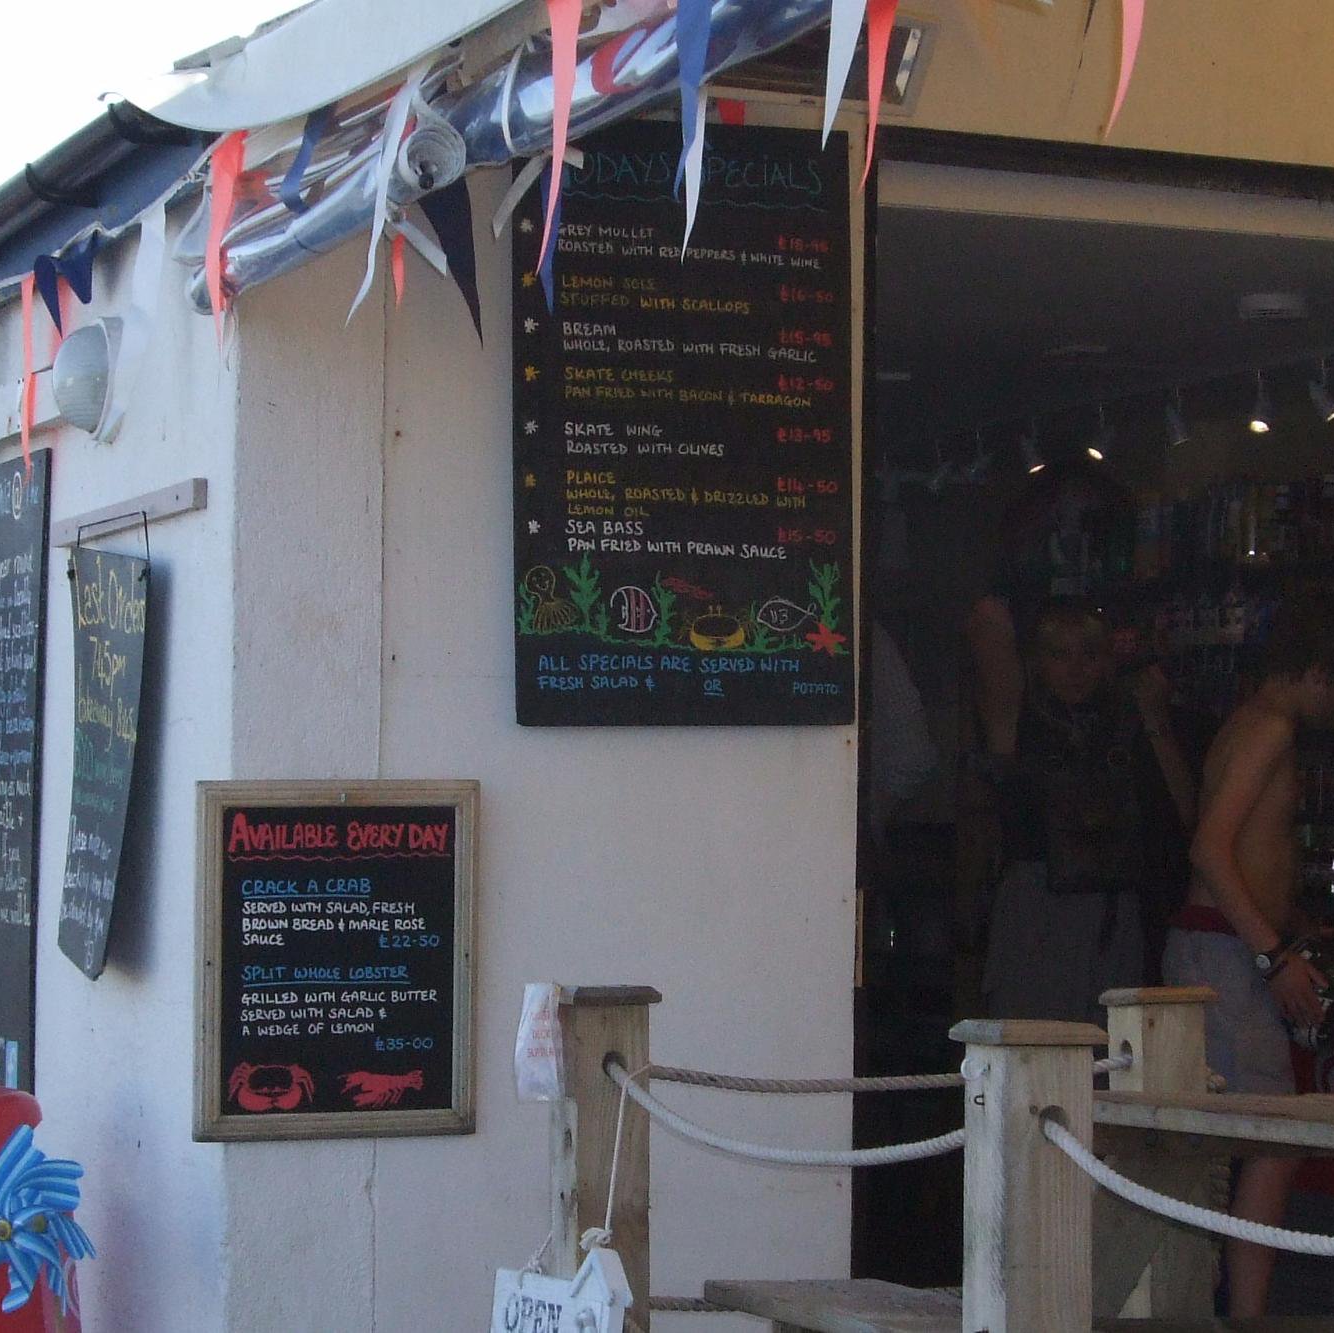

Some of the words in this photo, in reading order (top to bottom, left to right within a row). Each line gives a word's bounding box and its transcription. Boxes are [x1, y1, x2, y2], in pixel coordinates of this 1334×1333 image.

[570, 152, 671, 186] ODAYS
[703, 154, 825, 197] PECIALS
[599, 226, 654, 238] MULLET
[559, 239, 614, 255] ROASTED
[622, 245, 653, 257] WITH
[659, 246, 682, 259] RED
[686, 247, 735, 262] PEPPERS
[751, 252, 784, 266] WHITE
[791, 256, 821, 269] WINE
[563, 275, 613, 289] LEMON
[625, 277, 656, 290] SOLE
[560, 292, 635, 306] STUFFED
[640, 296, 675, 310] WITH
[682, 299, 751, 314] SCALLOPS
[563, 321, 616, 336] BREAM
[564, 338, 610, 352] WHOLE,
[618, 338, 675, 352] ROASTED
[683, 342, 714, 355] WITH
[719, 344, 761, 358] FRESH
[768, 347, 817, 363] GARLIC
[565, 367, 614, 380] SKATE
[621, 369, 674, 383] CHEEKS
[565, 386, 594, 399] PAN
[596, 386, 635, 400] FRIED
[640, 388, 672, 400] WITH
[679, 389, 723, 401] BACON
[743, 391, 811, 408] TARRAGON
[565, 422, 614, 436] SKATE
[626, 425, 663, 437] WING
[567, 442, 628, 455] ROASTED
[638, 443, 672, 455] WITH
[678, 443, 725, 457] OLIVES
[567, 471, 616, 485] PLAICE
[566, 488, 615, 501] WHOLE,
[625, 489, 685, 502] ROASTED
[704, 491, 768, 505] DRIZZLED
[777, 495, 805, 508] WITH
[568, 504, 614, 516] LEMON
[624, 506, 650, 518] OIL
[566, 520, 595, 535] SEA
[603, 521, 643, 535] BASS
[568, 538, 595, 552] PAN
[601, 540, 641, 552] FRIED
[647, 541, 681, 553] WITH
[688, 542, 735, 556] PRAWN
[740, 545, 786, 560] SAUCE
[73, 555, 106, 630] Last
[108, 562, 146, 634] Orders
[539, 655, 570, 671] ALL
[581, 655, 653, 671] SPECIALS
[660, 656, 692, 672] ARE
[699, 656, 755, 672] SERVED
[760, 657, 799, 672] WITH
[538, 675, 583, 691] FRESH
[591, 675, 638, 688] SALAD
[704, 678, 722, 691] OR
[229, 812, 337, 851] AVAILABLE
[347, 821, 404, 850] EVERY
[409, 823, 449, 850] DAY
[242, 879, 299, 894] CRACK
[307, 880, 318, 893] A
[326, 878, 372, 893] CRAB
[242, 902, 287, 914] SERVED
[292, 902, 321, 913] WITH
[325, 902, 370, 916] SALAD,
[373, 902, 415, 914] FRESH
[242, 919, 288, 931] BROWN
[293, 919, 334, 930] BREAD
[338, 918, 344, 932] &
[349, 919, 389, 931] MARIE
[395, 918, 426, 930] ROSE
[243, 934, 284, 946] SAUCE
[379, 935, 440, 948] £22-50
[241, 966, 286, 981] SPLIT
[295, 966, 340, 980] WHOLE
[349, 965, 408, 979] LOBSTER
[241, 991, 298, 1005] GRILLED
[305, 991, 336, 1003] WITH
[341, 990, 386, 1002] GARLIC
[391, 989, 437, 1001] BUTTER
[240, 1009, 285, 1022] SERVED
[291, 1009, 323, 1020] WITH
[329, 1008, 374, 1019] SALAD
[379, 1009, 387, 1019] &
[242, 1025, 250, 1036] A
[258, 1024, 300, 1036] WEDGE
[308, 1023, 324, 1034] OF
[331, 1022, 374, 1034] LEMON
[376, 1037, 433, 1051] £35-00
[505, 1292, 562, 1333] OPEN
